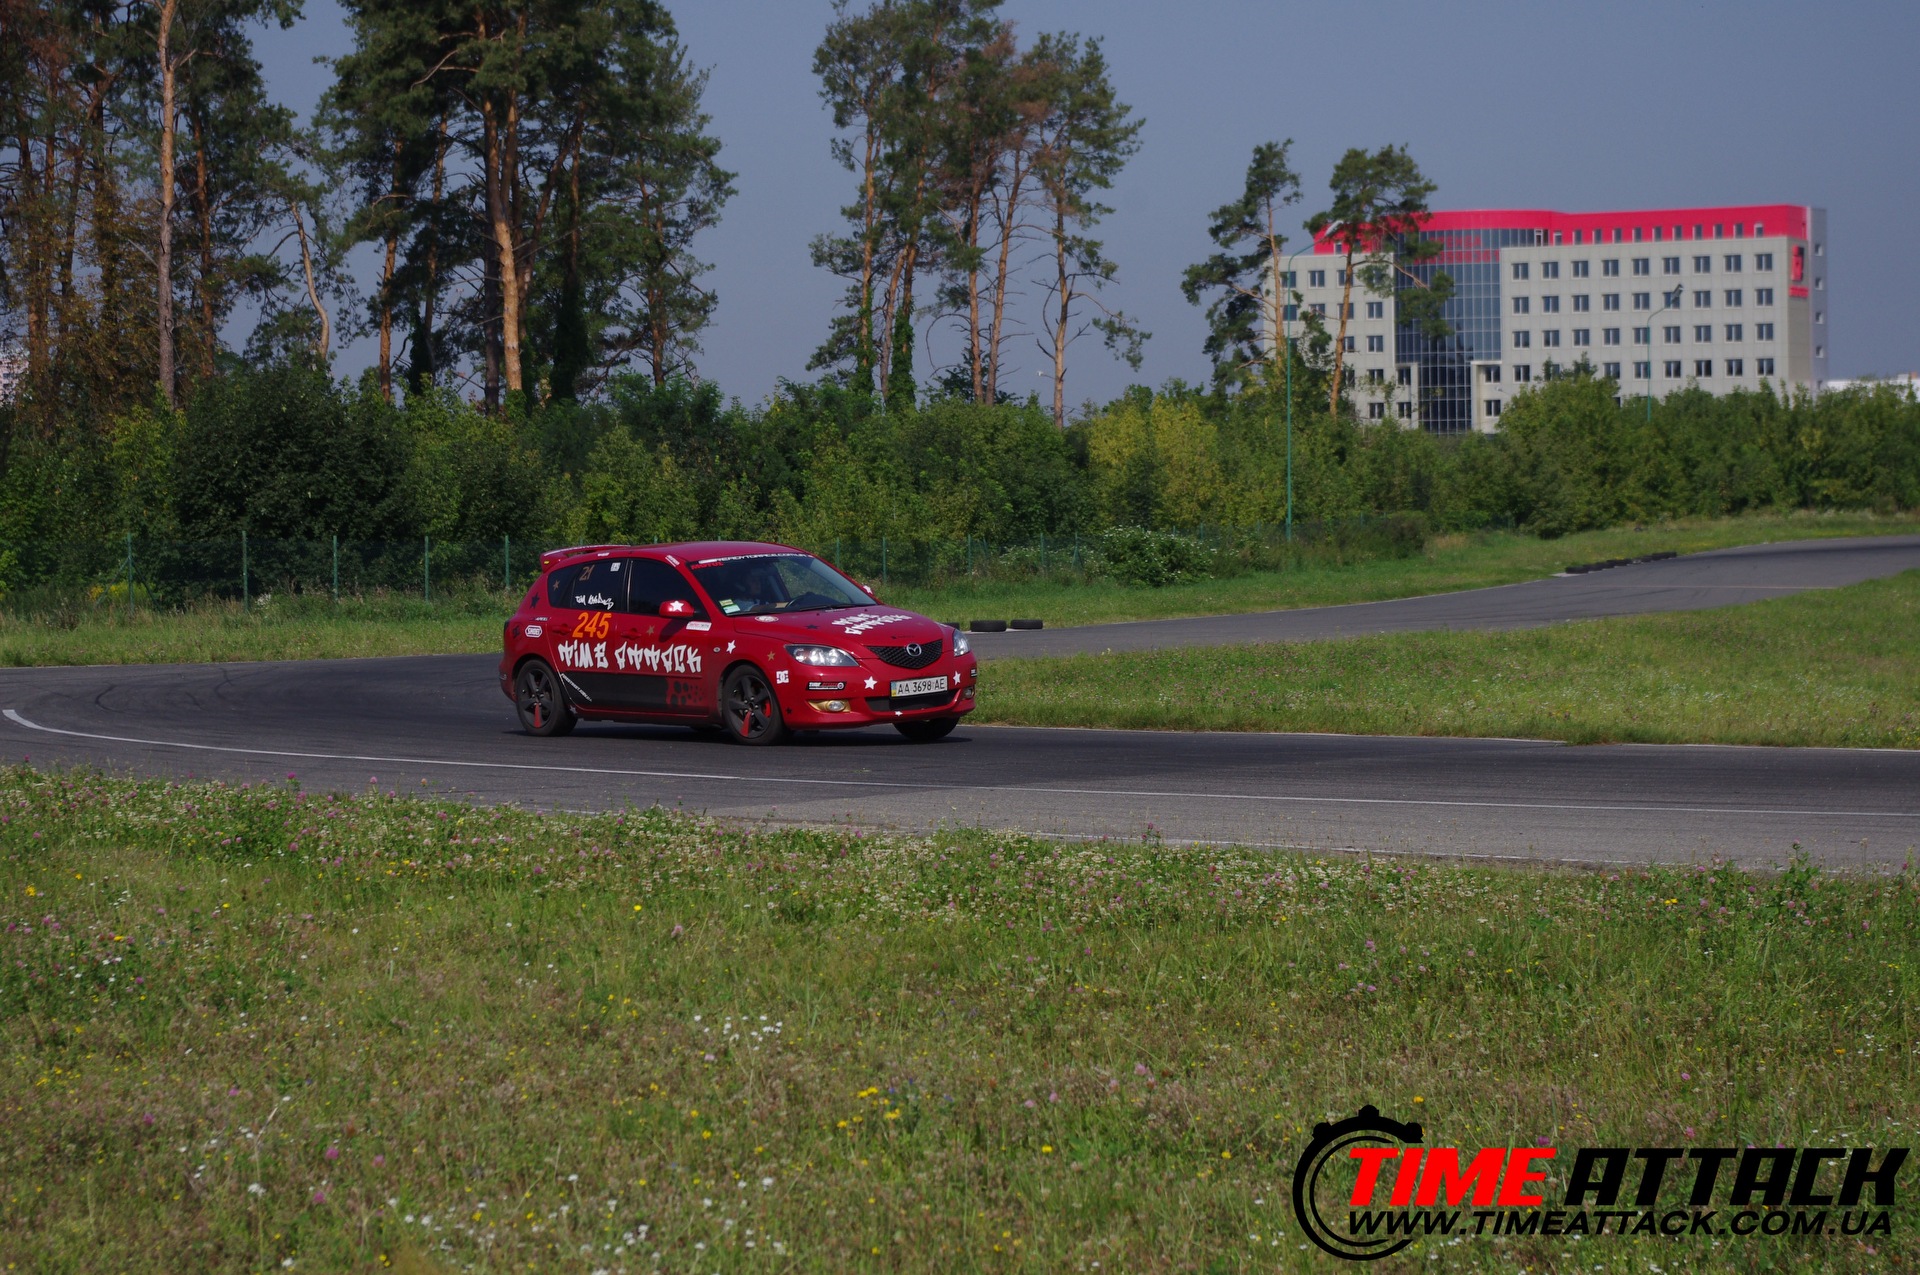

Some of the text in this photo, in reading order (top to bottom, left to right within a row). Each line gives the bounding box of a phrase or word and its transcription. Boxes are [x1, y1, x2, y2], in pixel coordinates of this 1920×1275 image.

[572, 611, 613, 640] 245
[614, 641, 702, 674] ATTACK
[897, 678, 945, 695] AA 3698 AE
